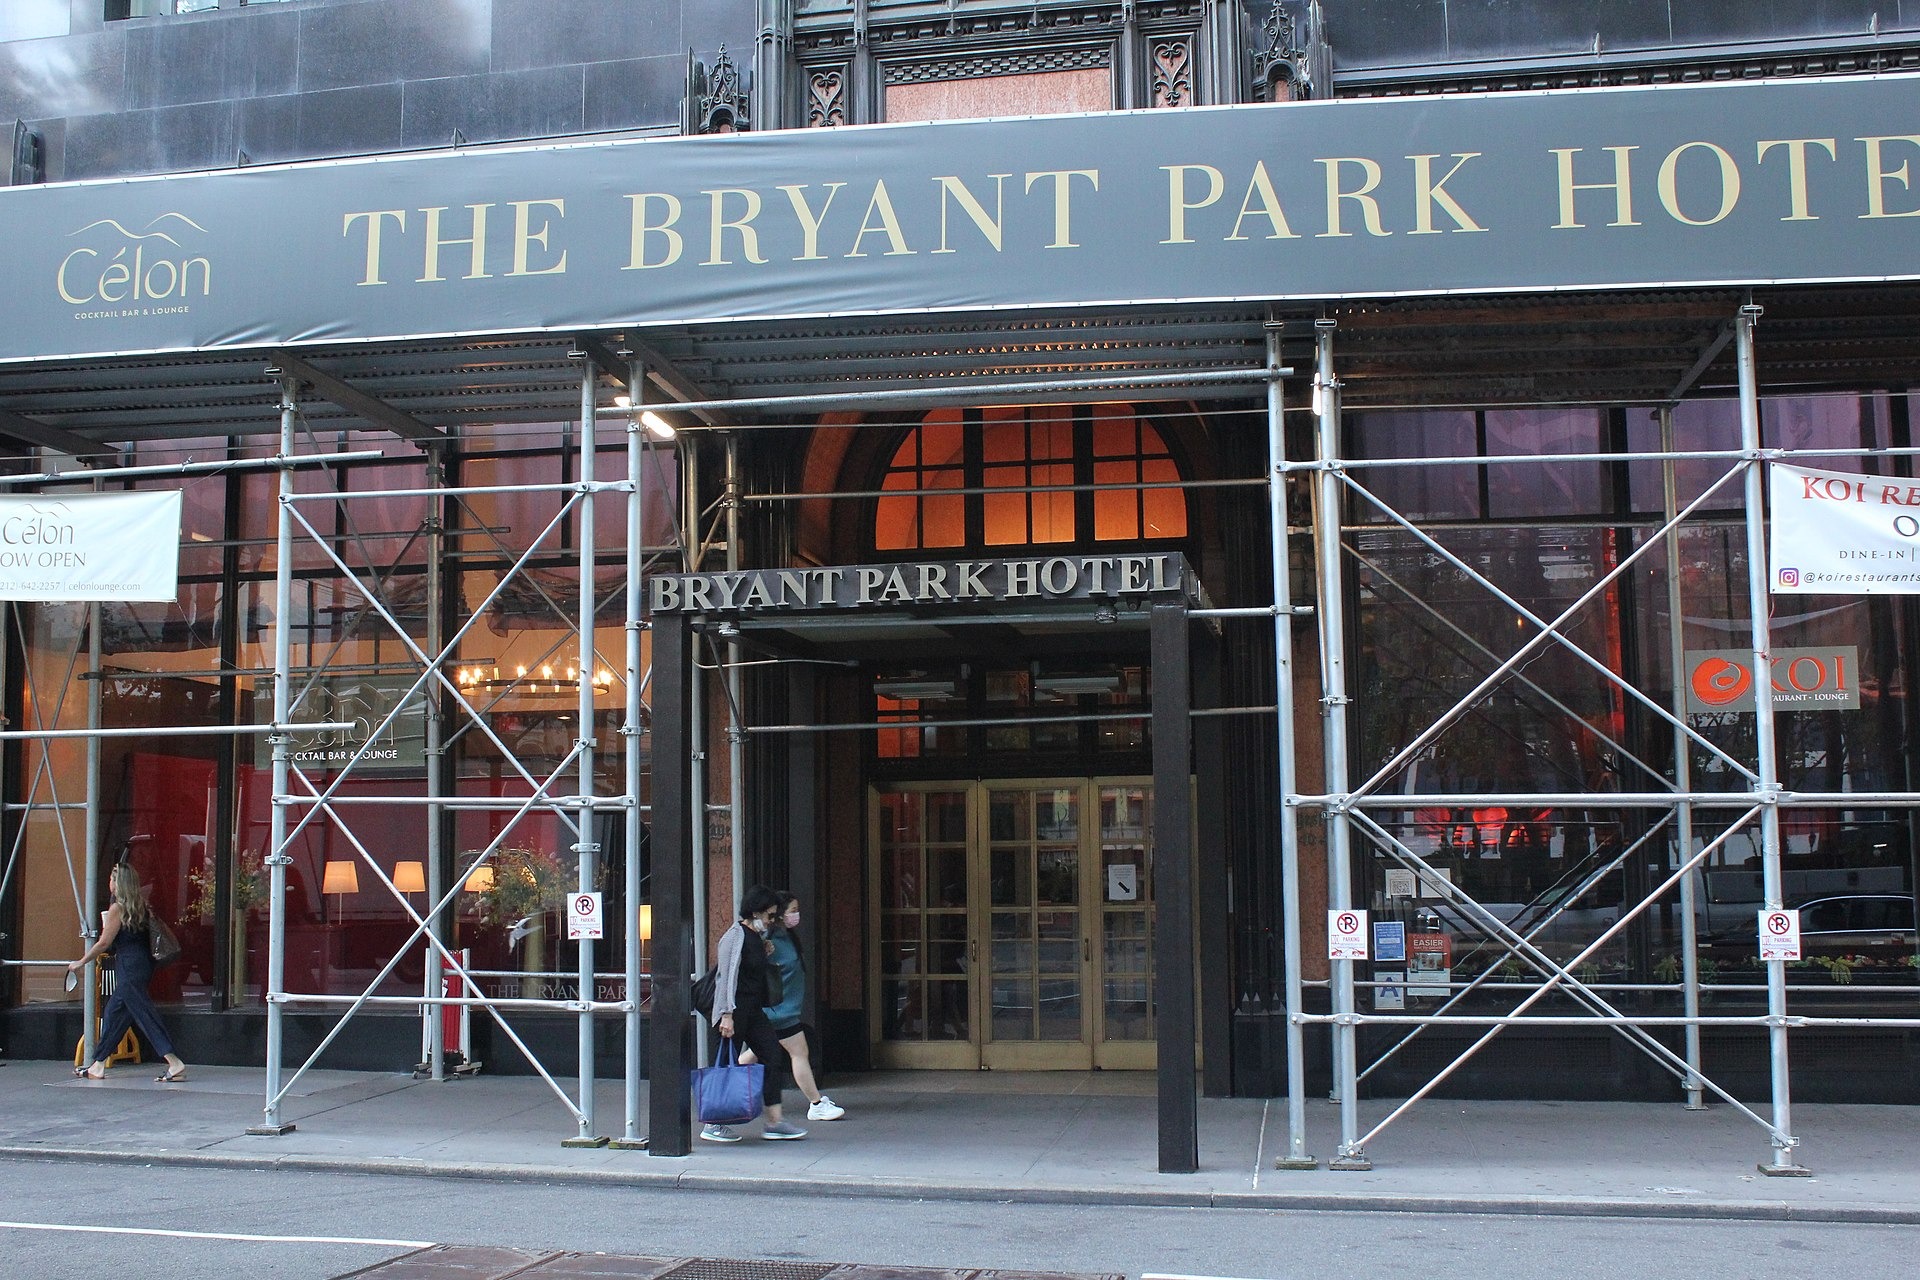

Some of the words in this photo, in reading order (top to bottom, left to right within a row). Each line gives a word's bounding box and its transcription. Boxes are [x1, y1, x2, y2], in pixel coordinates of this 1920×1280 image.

[343, 198, 567, 287] THE
[620, 168, 1099, 271] BRYANT
[1158, 152, 1490, 245] PARK
[1547, 134, 1920, 229] HOTE
[57, 245, 210, 304] Célon
[74, 309, 118, 320] COCKTAIL
[122, 309, 139, 317] BAR
[142, 308, 149, 316] &
[152, 306, 189, 314] LOUNGE
[1801, 476, 1867, 503] KOI
[3, 516, 74, 545] Célon
[0, 551, 33, 568] OW
[38, 551, 87, 568] OPEN
[1839, 550, 1905, 559] DINE-IN
[68, 581, 142, 592] celonlounge.com
[651, 568, 843, 612] BRYANT
[855, 562, 994, 604] PARK
[1003, 555, 1181, 600] HOTEL
[1814, 693, 1849, 701] LOUNGE
[295, 751, 326, 760] CKTAIL
[328, 751, 346, 760] BAR
[361, 750, 397, 759] OUNGE
[487, 984, 519, 998] THE
[539, 984, 580, 999] RYAN
[598, 985, 638, 1000] PAR
